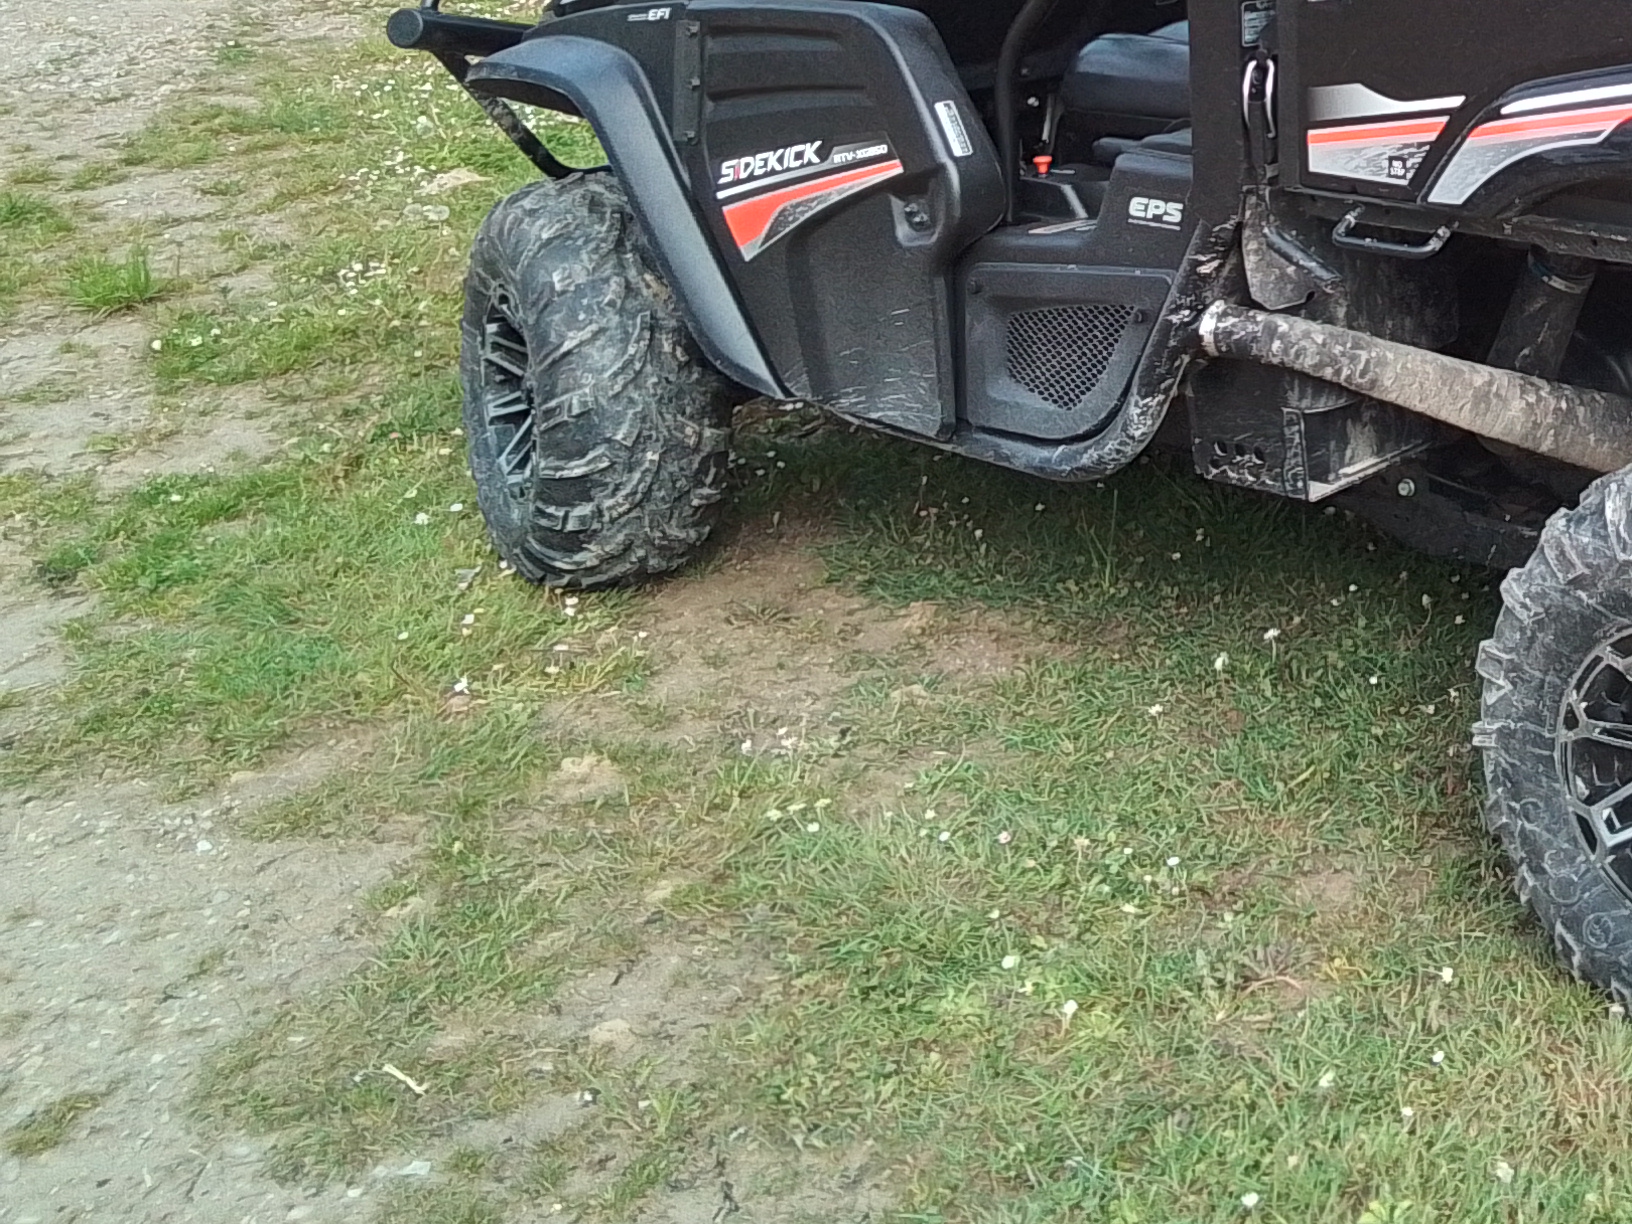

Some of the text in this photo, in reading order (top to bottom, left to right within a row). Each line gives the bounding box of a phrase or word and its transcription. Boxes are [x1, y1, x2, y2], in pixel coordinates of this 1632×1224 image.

[648, 6, 672, 21] EFI
[717, 139, 823, 185] SIDEKICK
[1128, 196, 1184, 223] EPS
